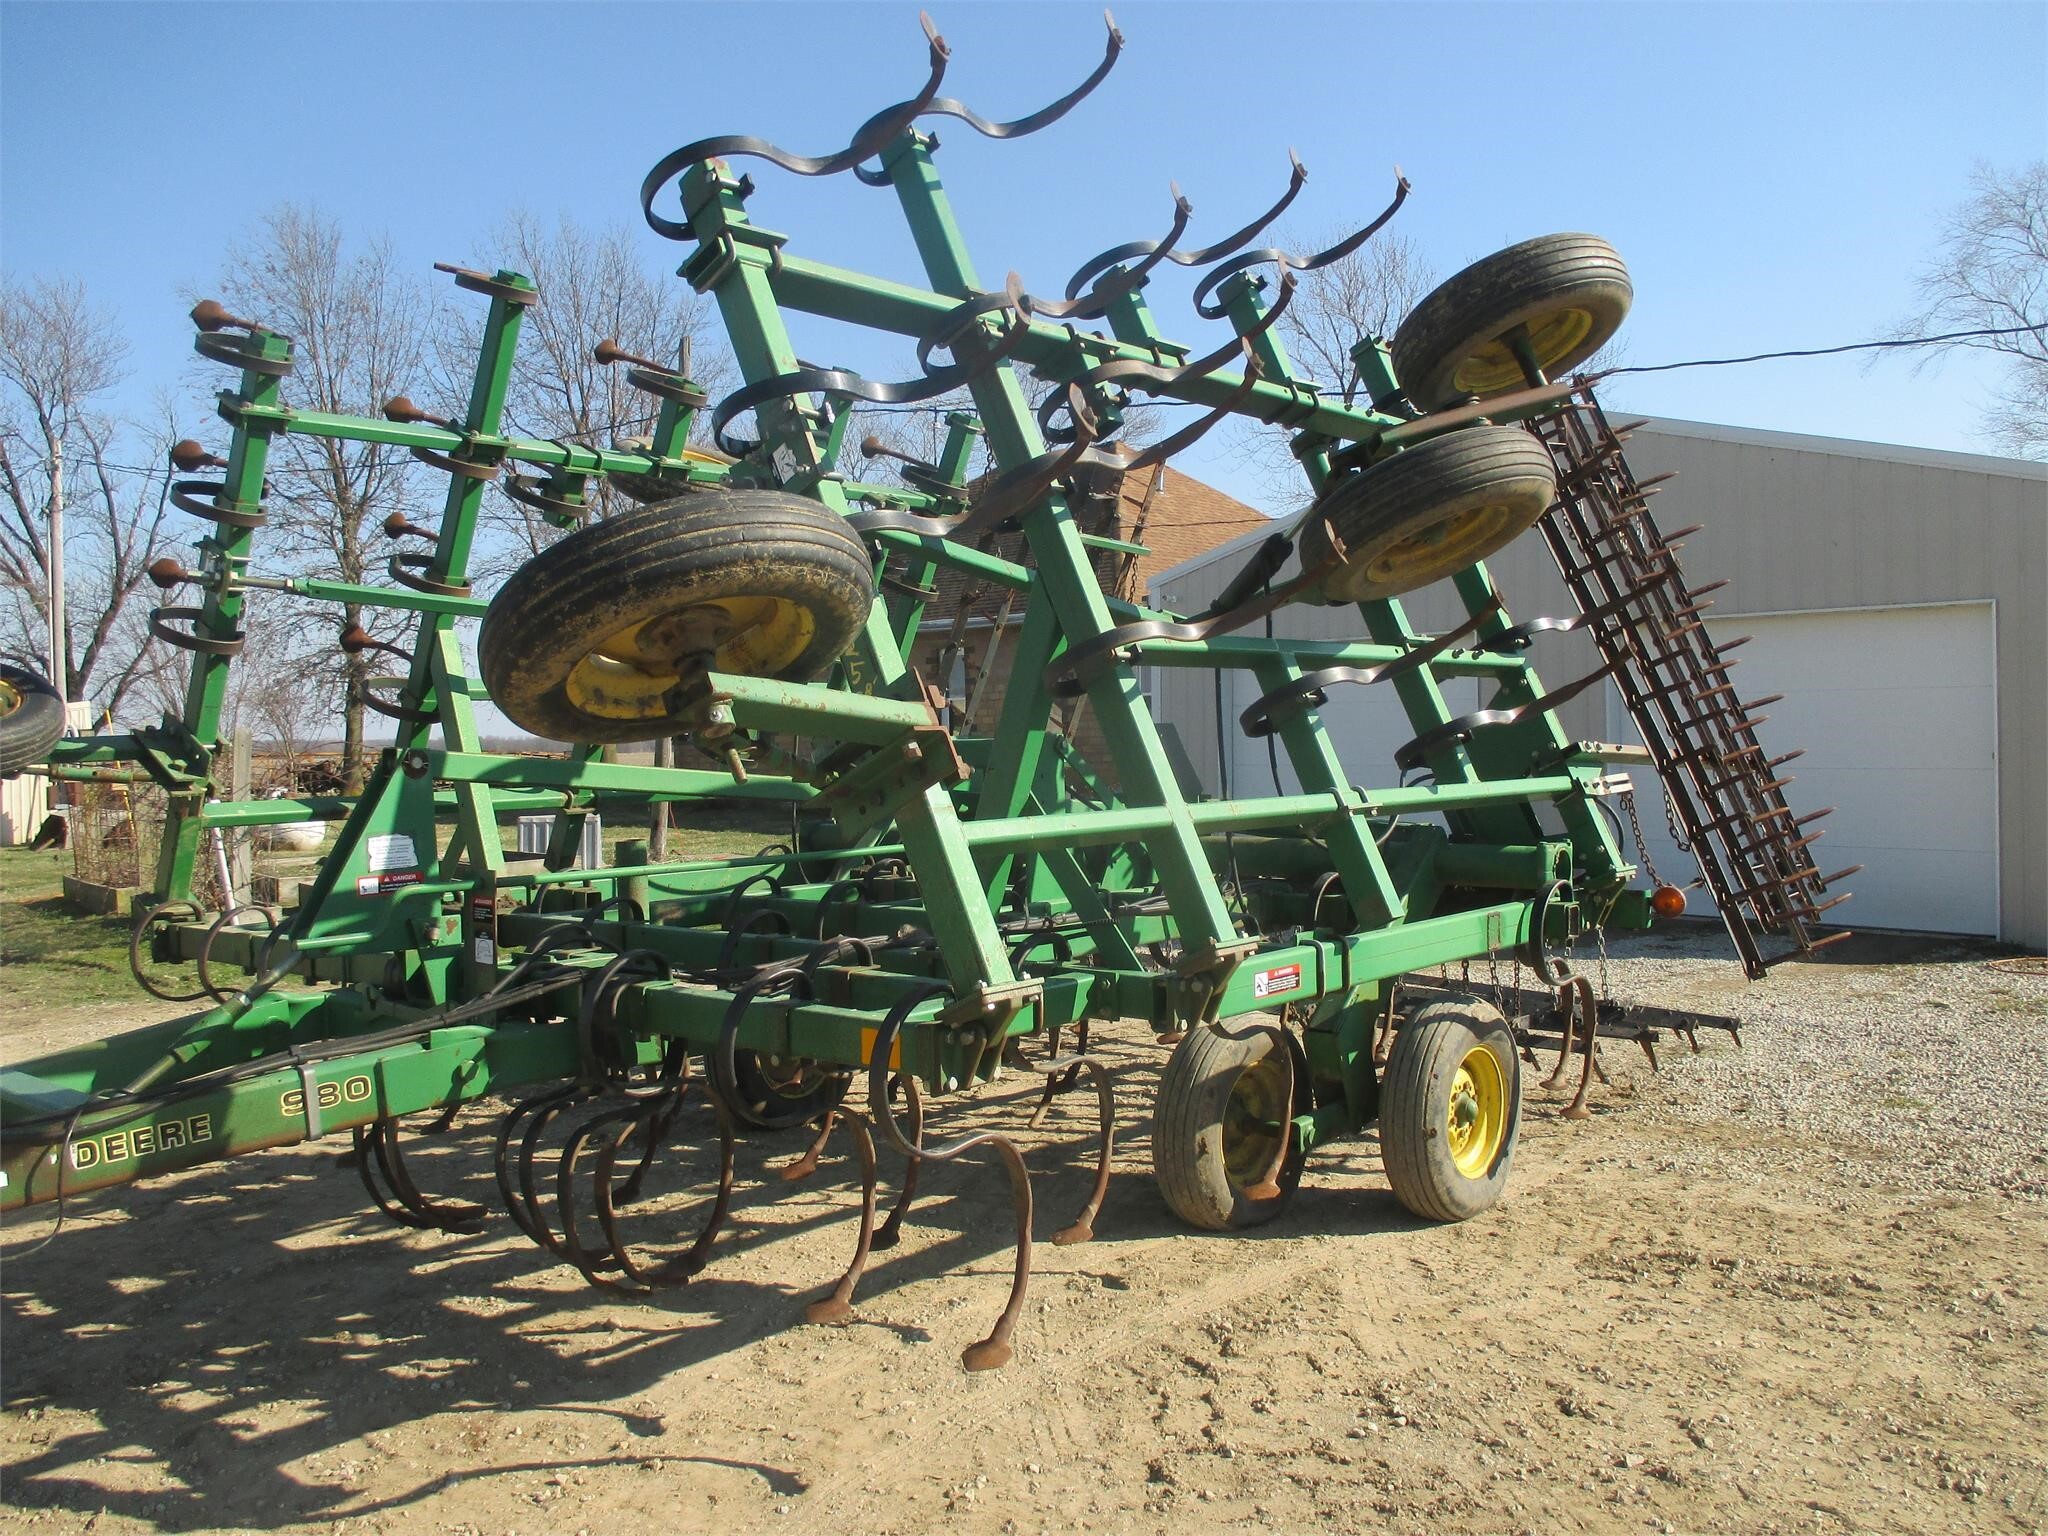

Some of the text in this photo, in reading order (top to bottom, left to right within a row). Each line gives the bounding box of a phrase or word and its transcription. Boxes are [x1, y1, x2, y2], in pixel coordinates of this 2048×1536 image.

[392, 873, 417, 882] DANGER
[73, 1075, 372, 1170] DEERE 980
